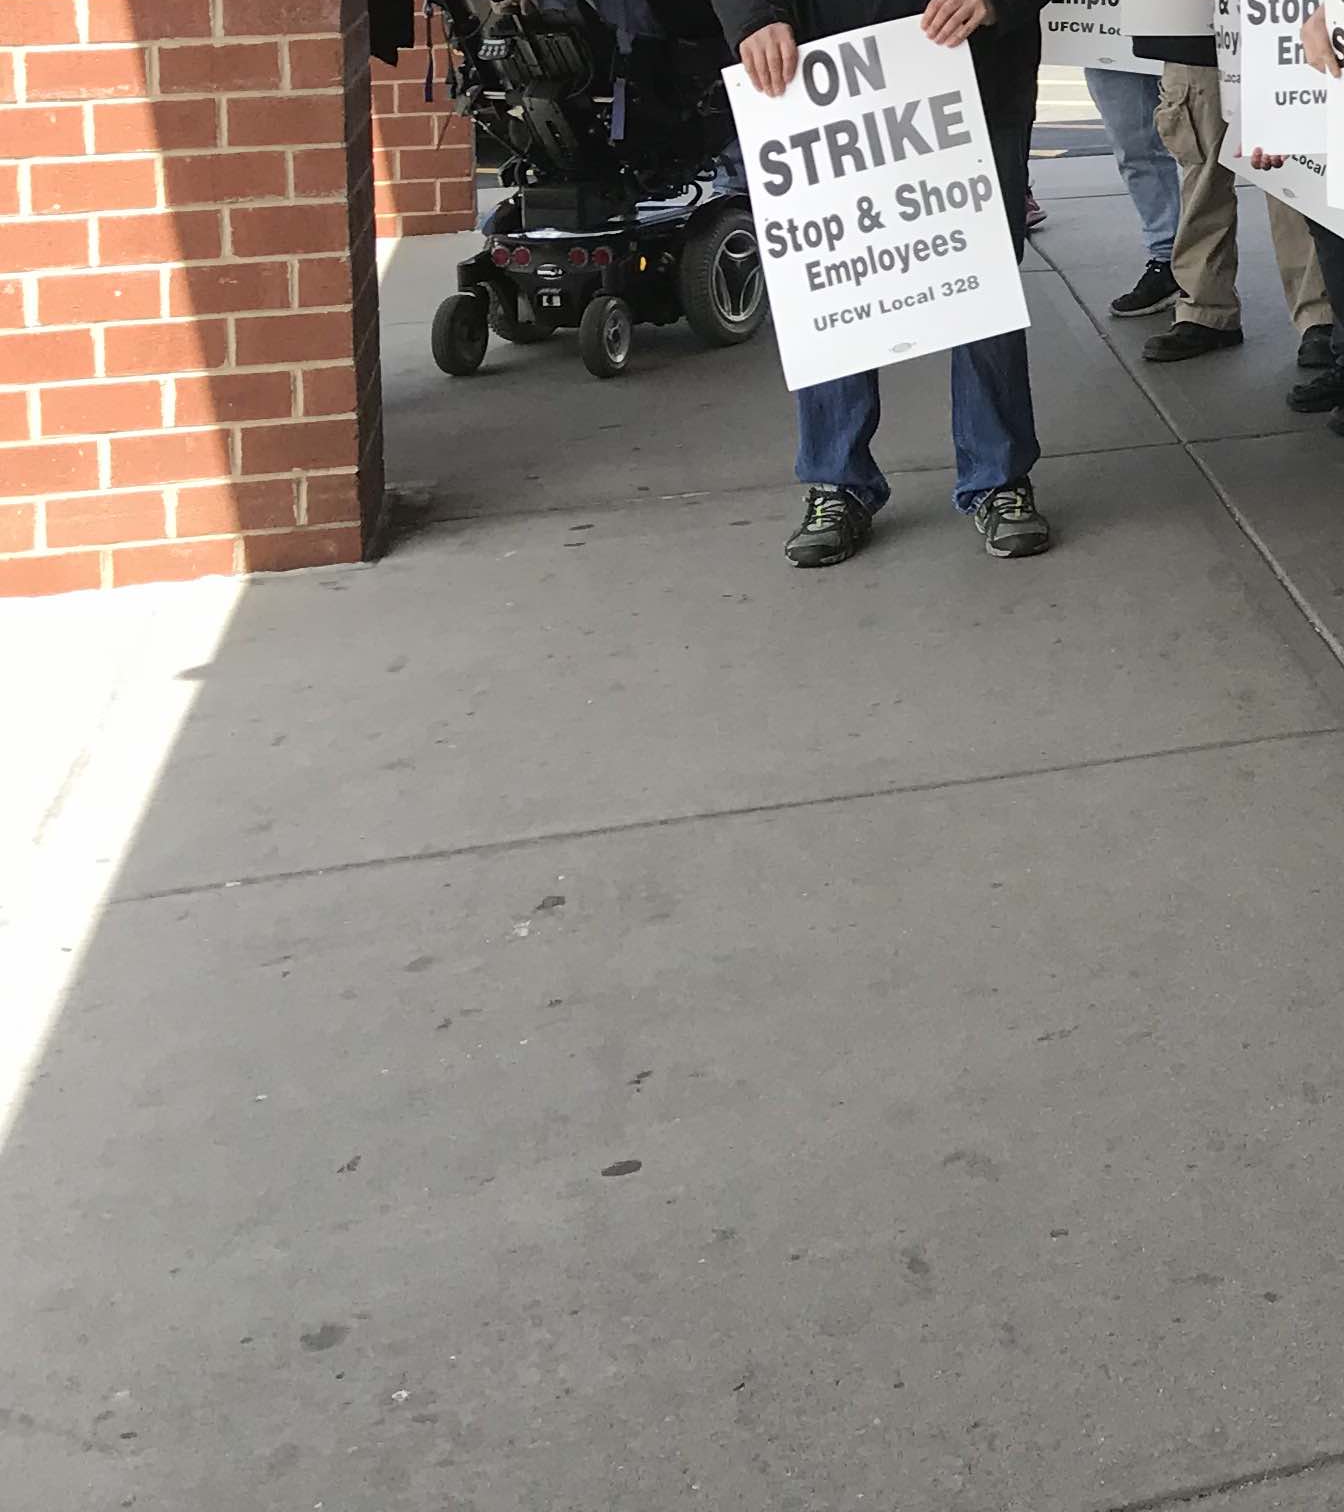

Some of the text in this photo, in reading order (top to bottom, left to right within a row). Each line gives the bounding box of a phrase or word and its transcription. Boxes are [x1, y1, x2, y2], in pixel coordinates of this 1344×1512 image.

[1048, 21, 1094, 33] UFCW
[802, 35, 886, 107] ON
[1275, 90, 1327, 106] UFCW
[760, 91, 972, 196] STRIKE
[765, 175, 992, 258] Stop & Shop
[806, 230, 967, 293] Employees
[814, 276, 979, 331] UFCW Local 328
